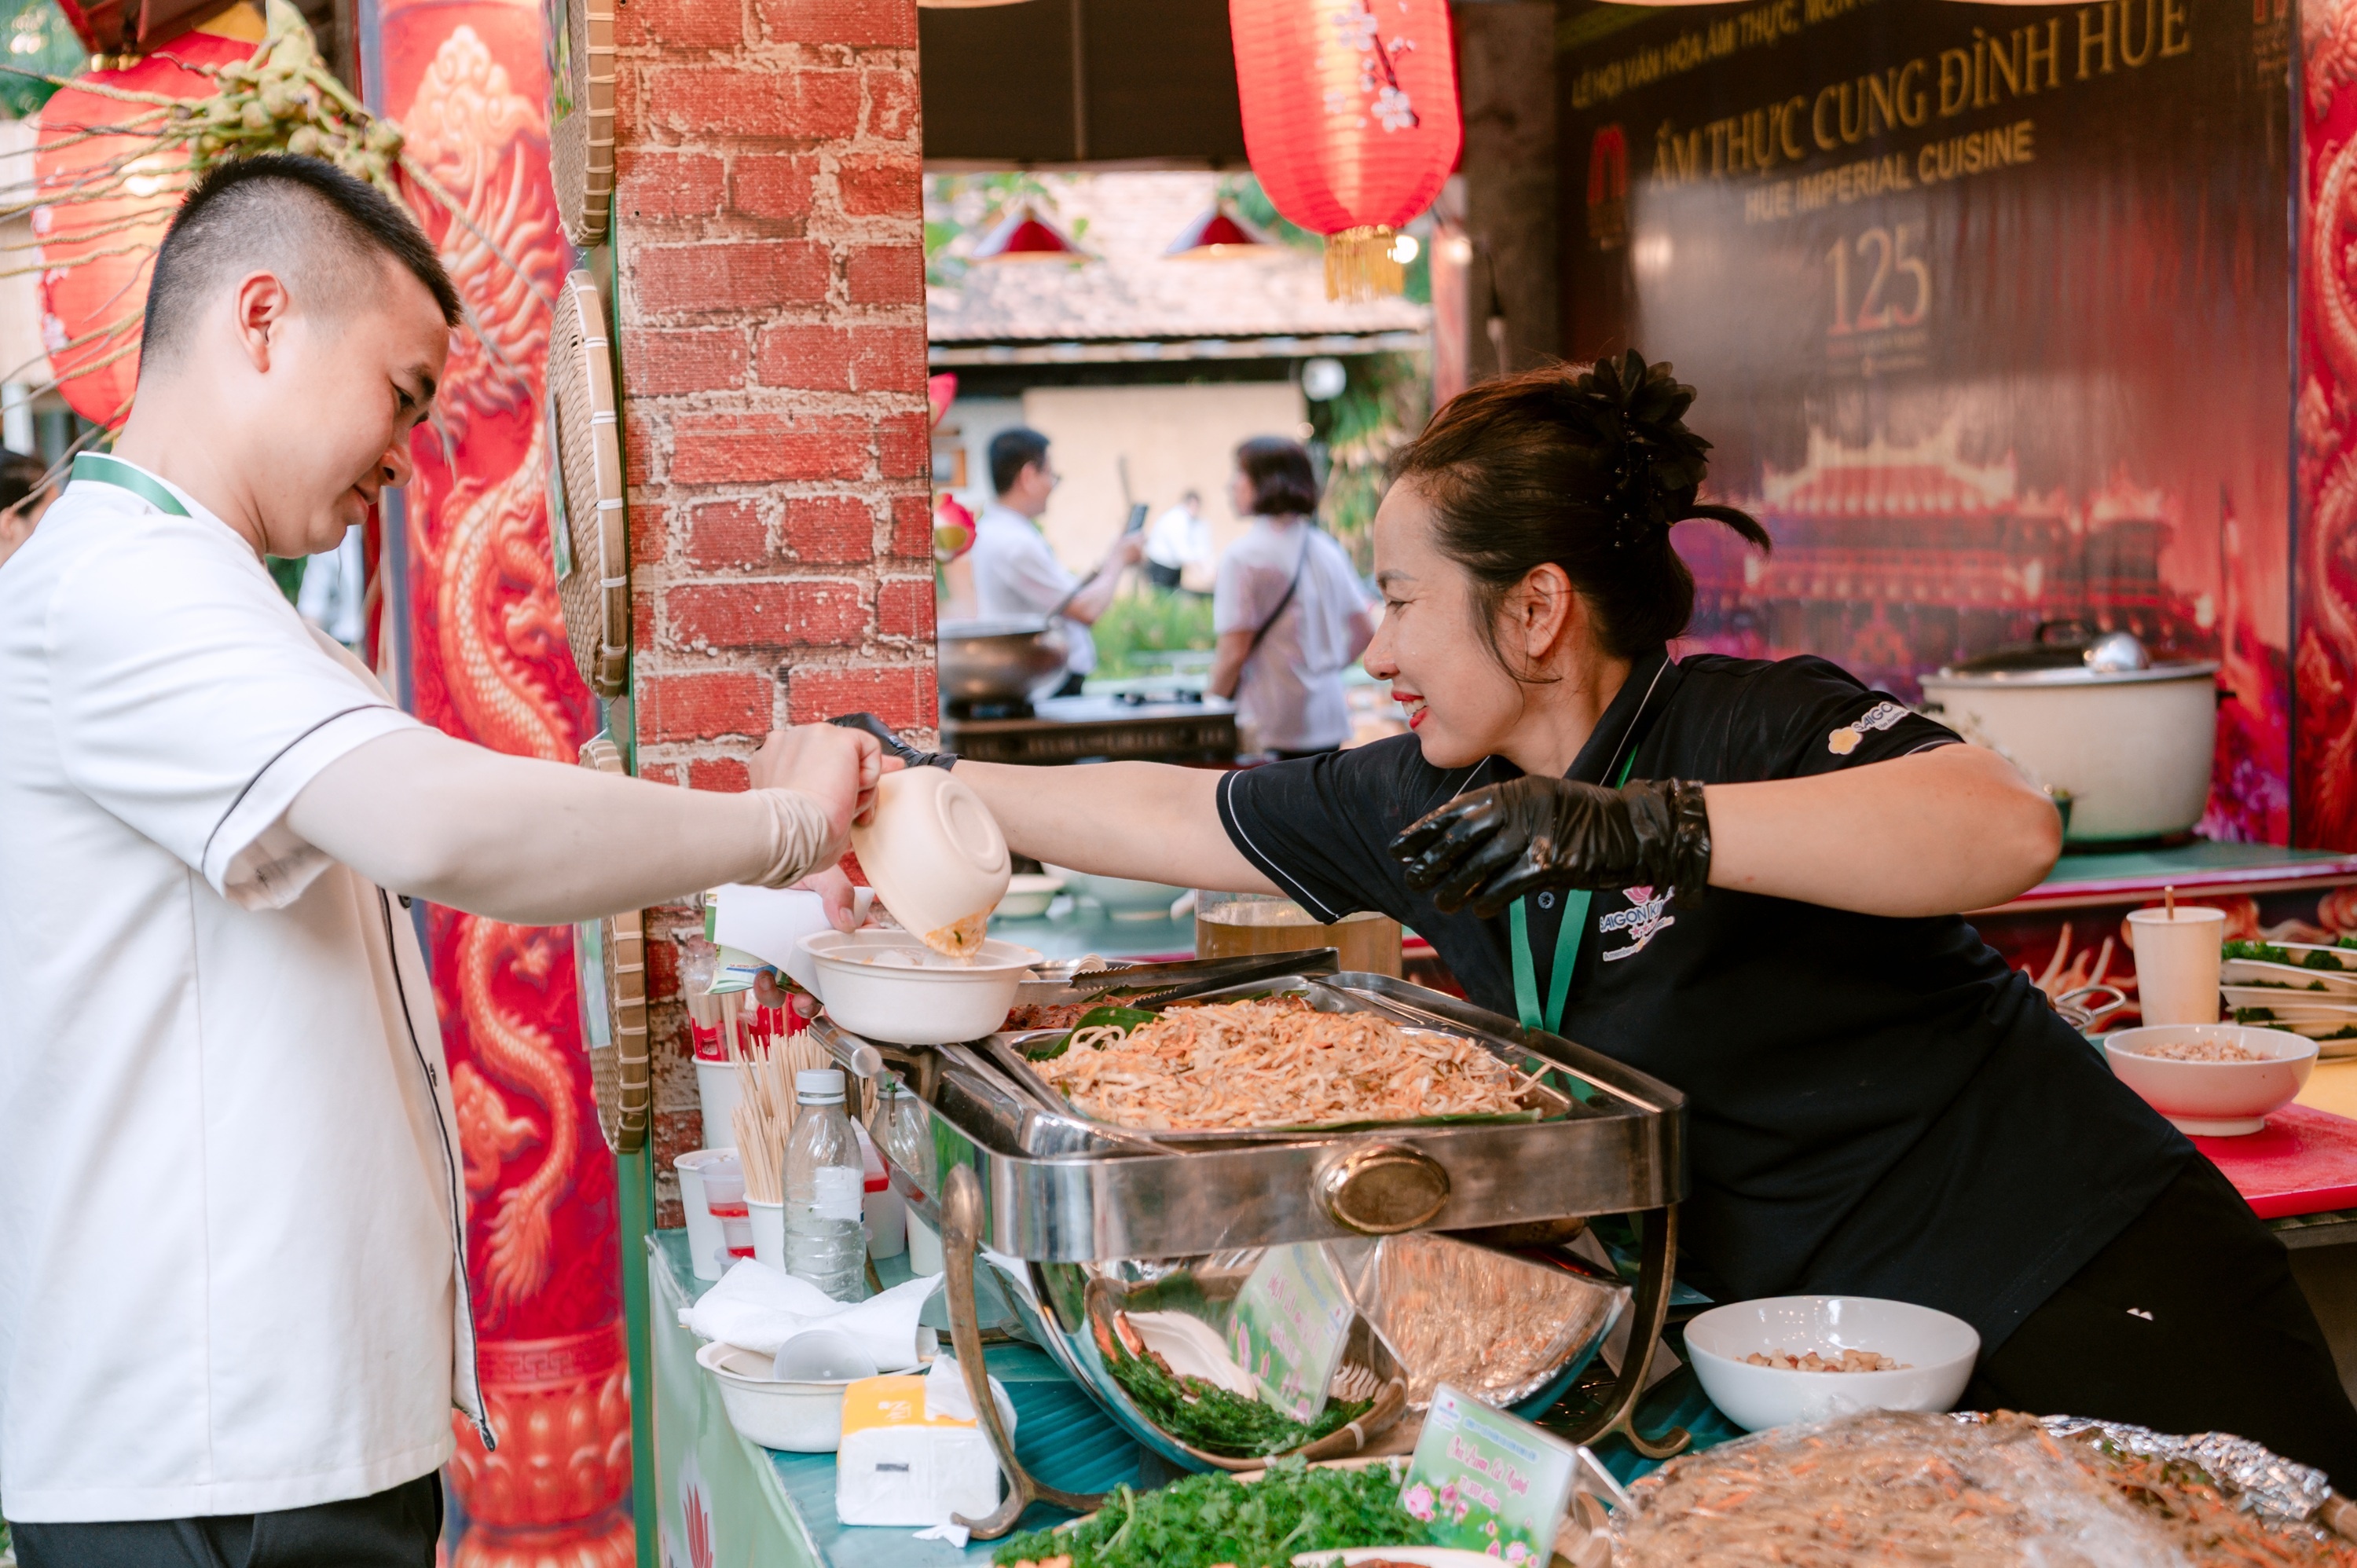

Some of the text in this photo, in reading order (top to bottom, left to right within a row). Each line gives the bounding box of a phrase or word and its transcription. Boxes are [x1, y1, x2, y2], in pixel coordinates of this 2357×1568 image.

[1705, 95, 1805, 179] THỰC
[1813, 57, 1928, 151] CUNG
[1937, 17, 2062, 118] ĐÌNH
[1795, 153, 1913, 211] IMPERIAL
[1918, 119, 2036, 185] CUISINE
[1824, 221, 1932, 336] 125
[1853, 703, 1895, 731] SAIGO
